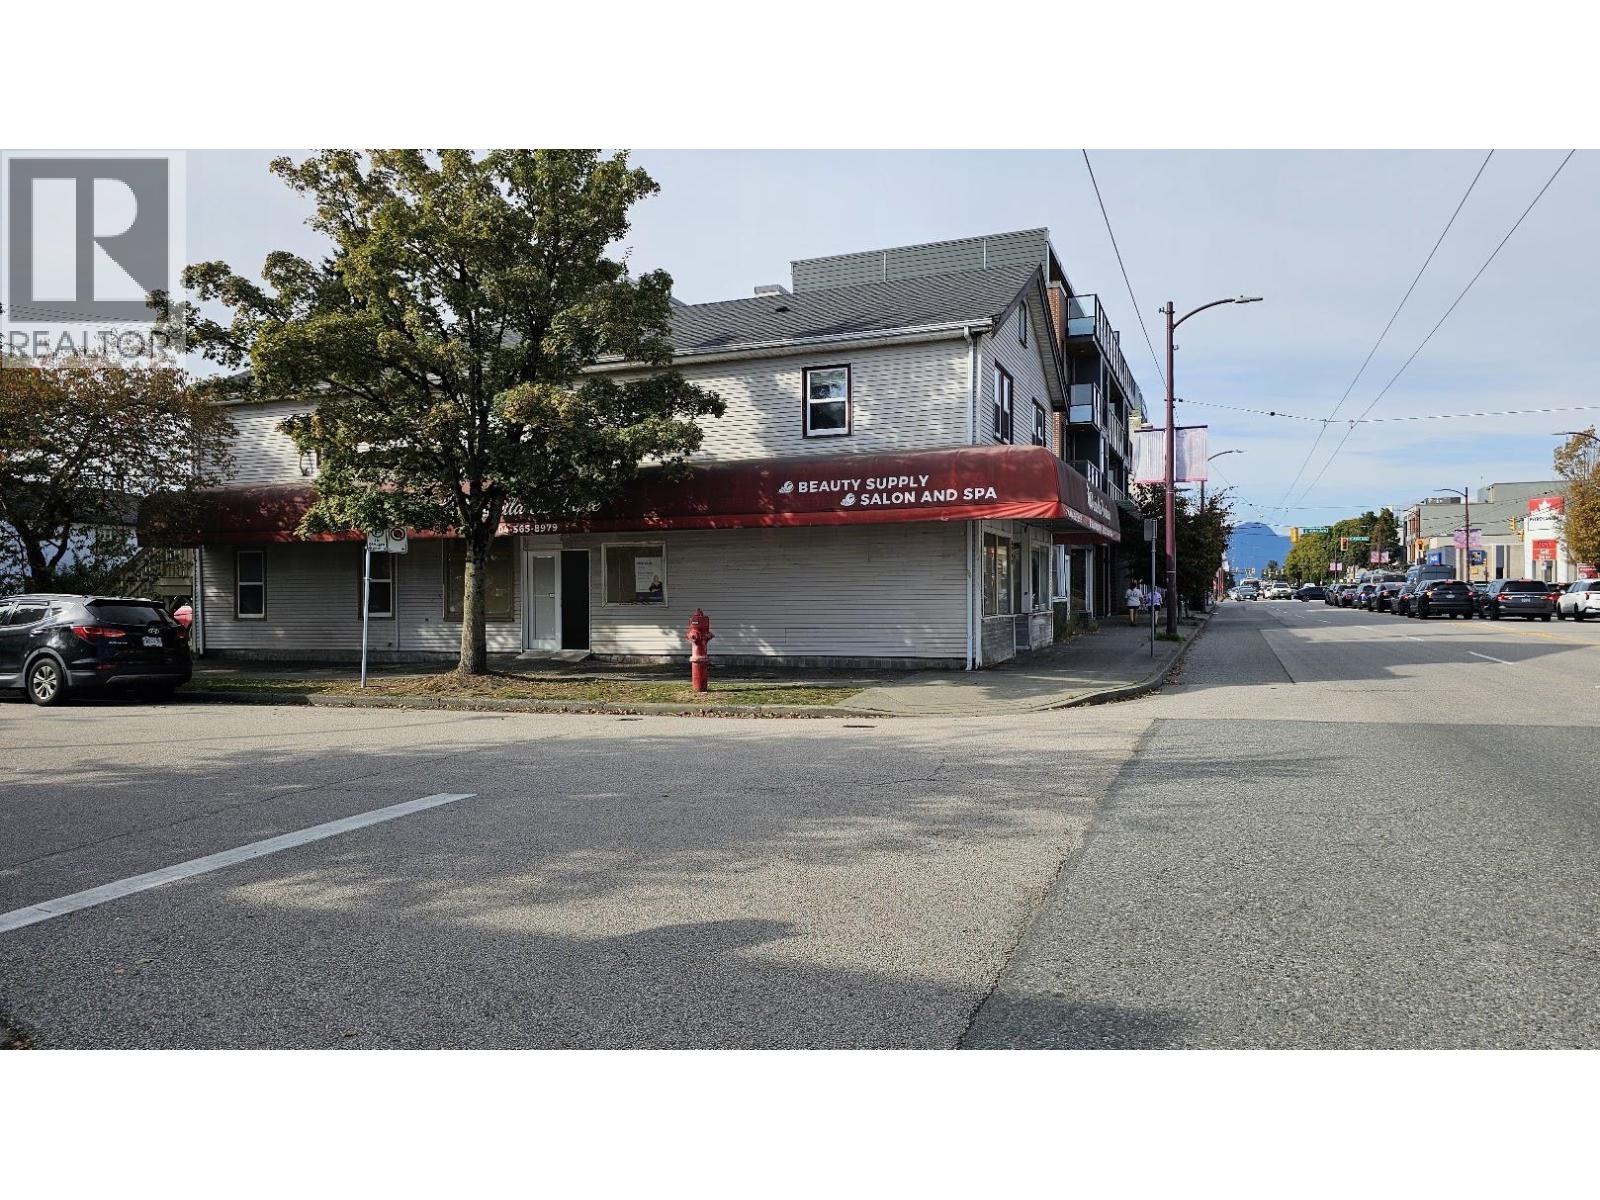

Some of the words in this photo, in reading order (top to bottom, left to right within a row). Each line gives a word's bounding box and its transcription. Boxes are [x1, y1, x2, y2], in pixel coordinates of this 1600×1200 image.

[798, 478, 861, 493] BEAUTY
[866, 475, 929, 490] SUPPLY
[860, 491, 916, 506] SALON
[921, 488, 957, 503] AND
[963, 487, 997, 500] SPA
[498, 523, 558, 534] 04-565-8979
